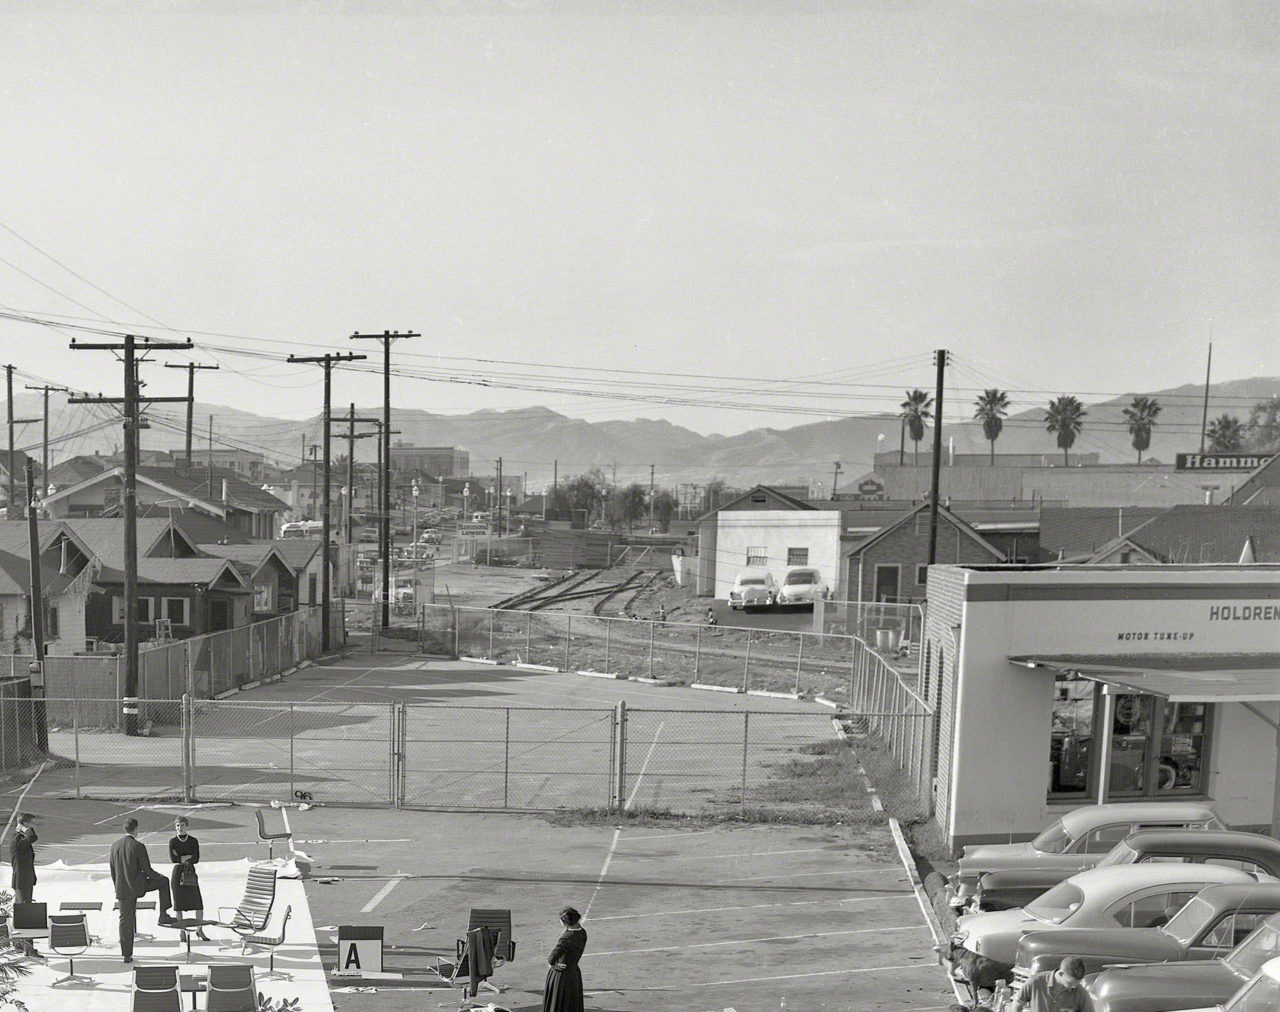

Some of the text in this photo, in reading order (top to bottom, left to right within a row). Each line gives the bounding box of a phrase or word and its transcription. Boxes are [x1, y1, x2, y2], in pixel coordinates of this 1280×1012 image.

[1117, 632, 1195, 641] MOTOR TUNE-UP
[344, 942, 361, 969] A
